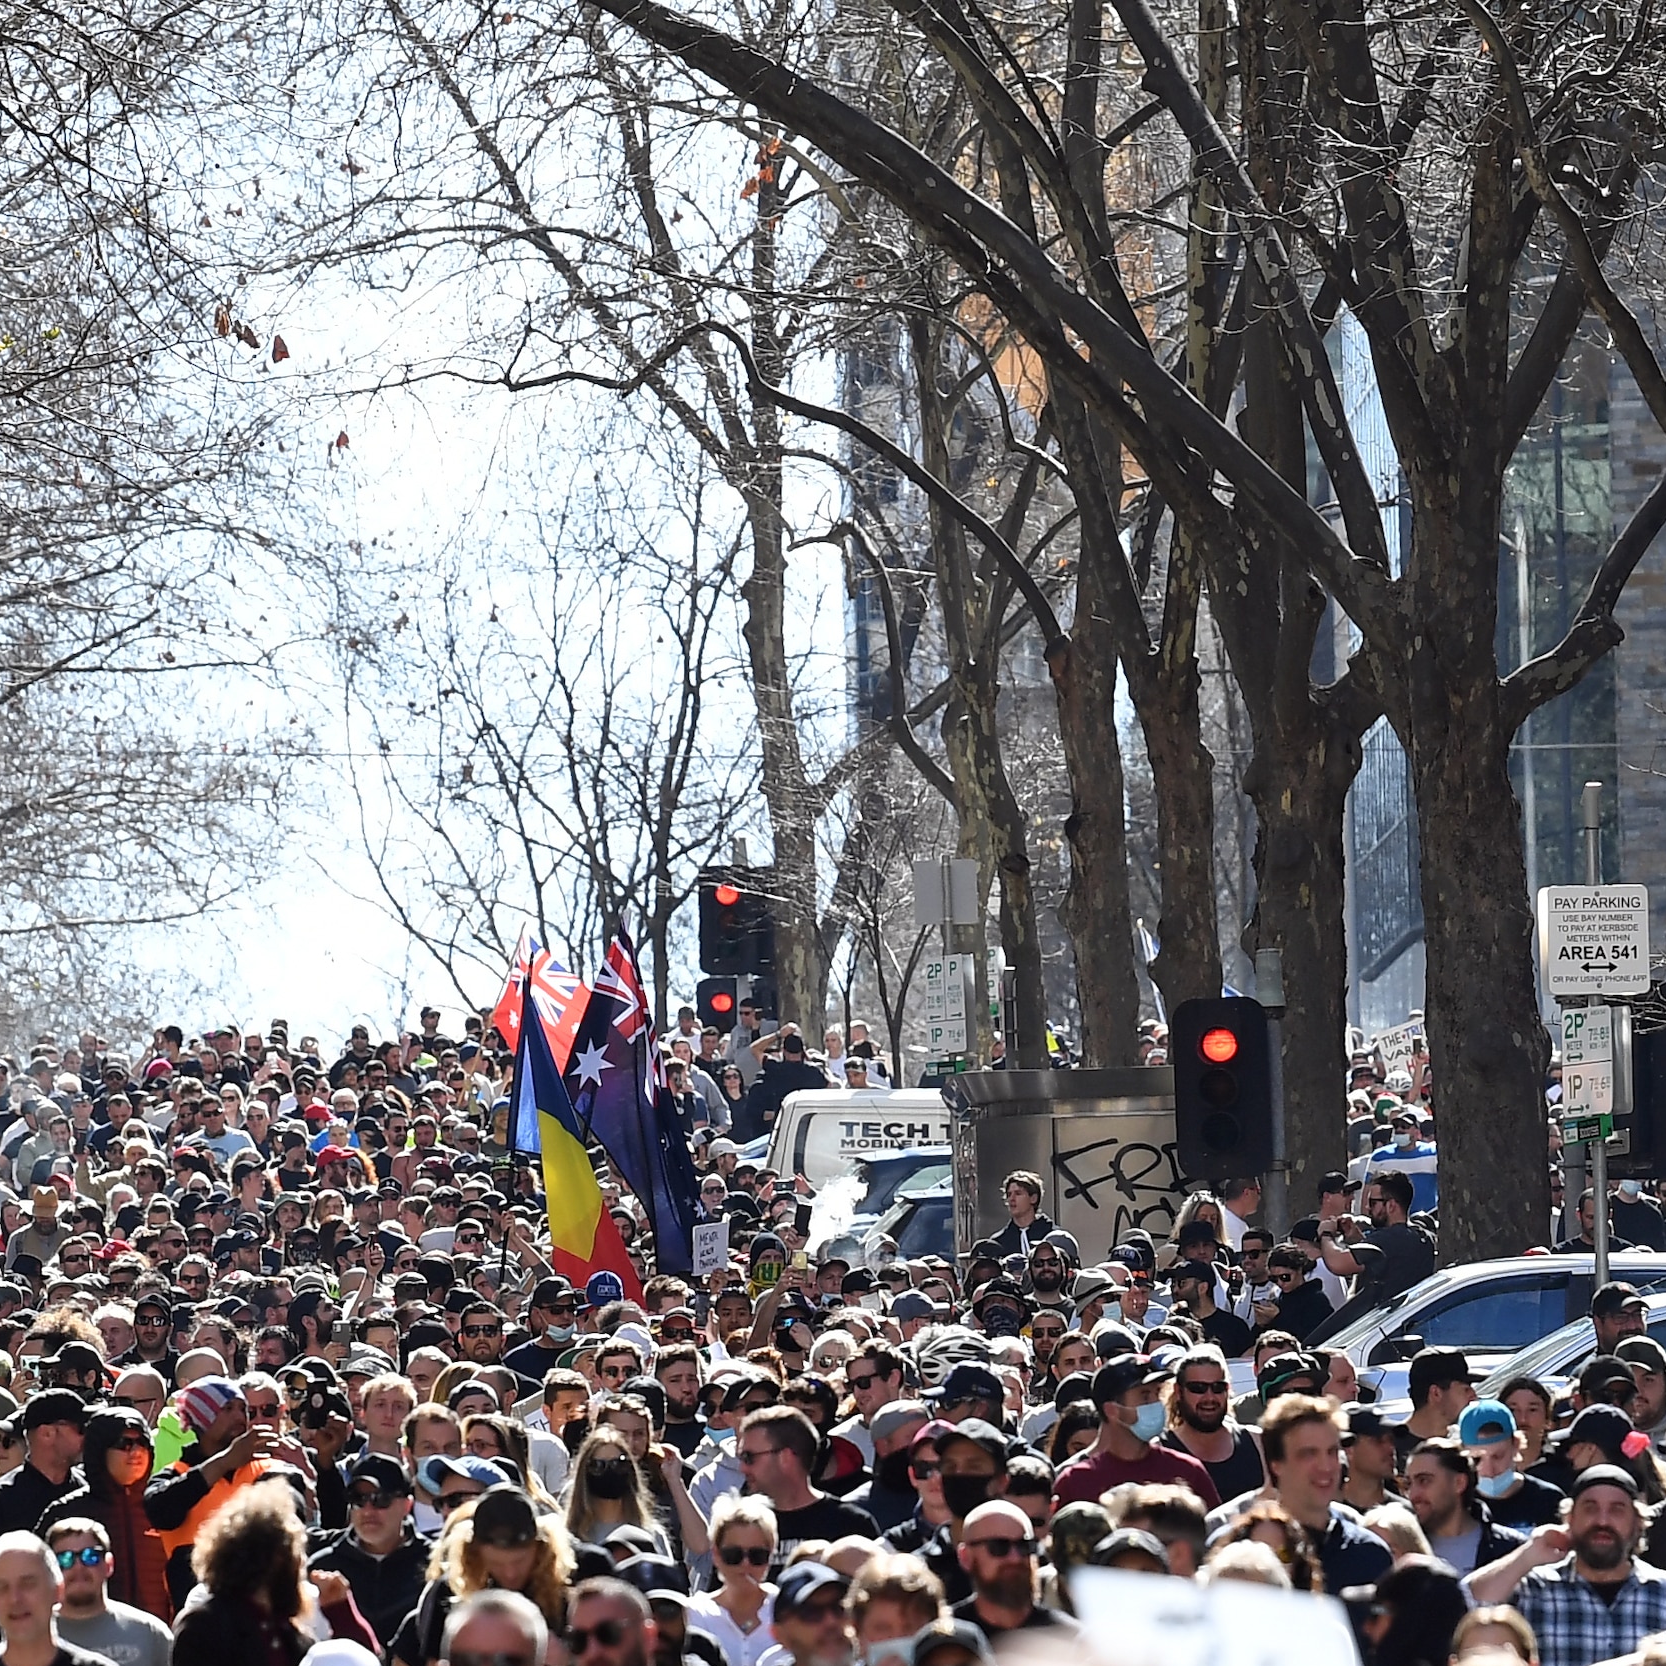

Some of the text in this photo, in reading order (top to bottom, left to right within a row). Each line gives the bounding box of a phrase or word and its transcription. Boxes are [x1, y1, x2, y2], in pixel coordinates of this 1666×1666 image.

[1554, 897, 1641, 909] PAY PARKING
[1562, 914, 1579, 922] USE
[1581, 914, 1597, 922] BAY
[1570, 924, 1585, 932] PAY
[1601, 934, 1631, 942] WITHIN
[1558, 945, 1638, 960] AREA 541
[927, 961, 957, 979] 2P P
[1564, 1013, 1584, 1039] 2P
[931, 1027, 943, 1043] 1P
[1381, 1031, 1403, 1049] THE
[1568, 1074, 1583, 1100] 1P
[838, 1121, 931, 1139] TECH
[840, 1139, 913, 1149] MOBILE
